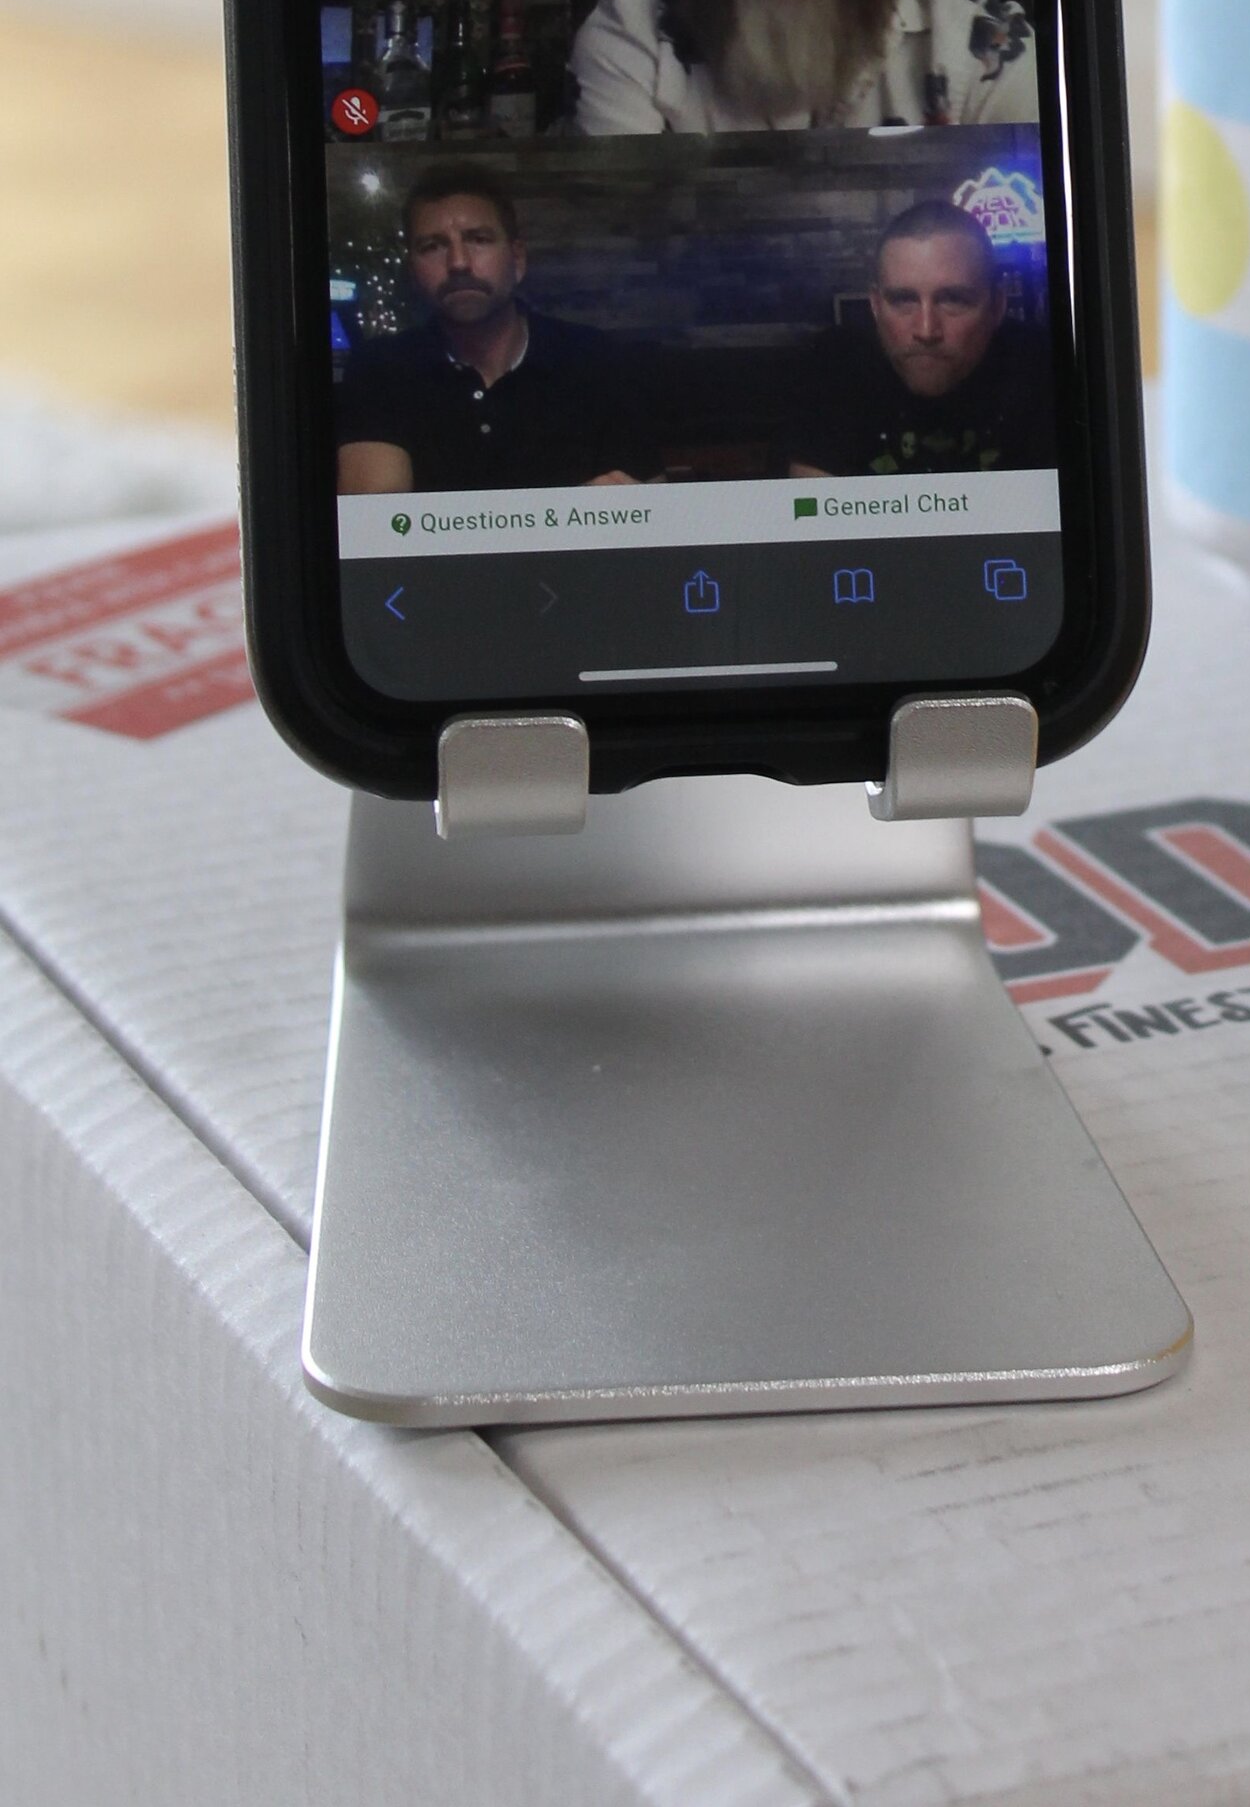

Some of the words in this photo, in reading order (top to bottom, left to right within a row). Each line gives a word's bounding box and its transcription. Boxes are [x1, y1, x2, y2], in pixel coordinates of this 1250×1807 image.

[823, 494, 909, 517] General
[917, 493, 970, 514] Chat
[420, 507, 536, 534] Questions
[544, 508, 560, 527] &
[567, 505, 653, 527] Answer
